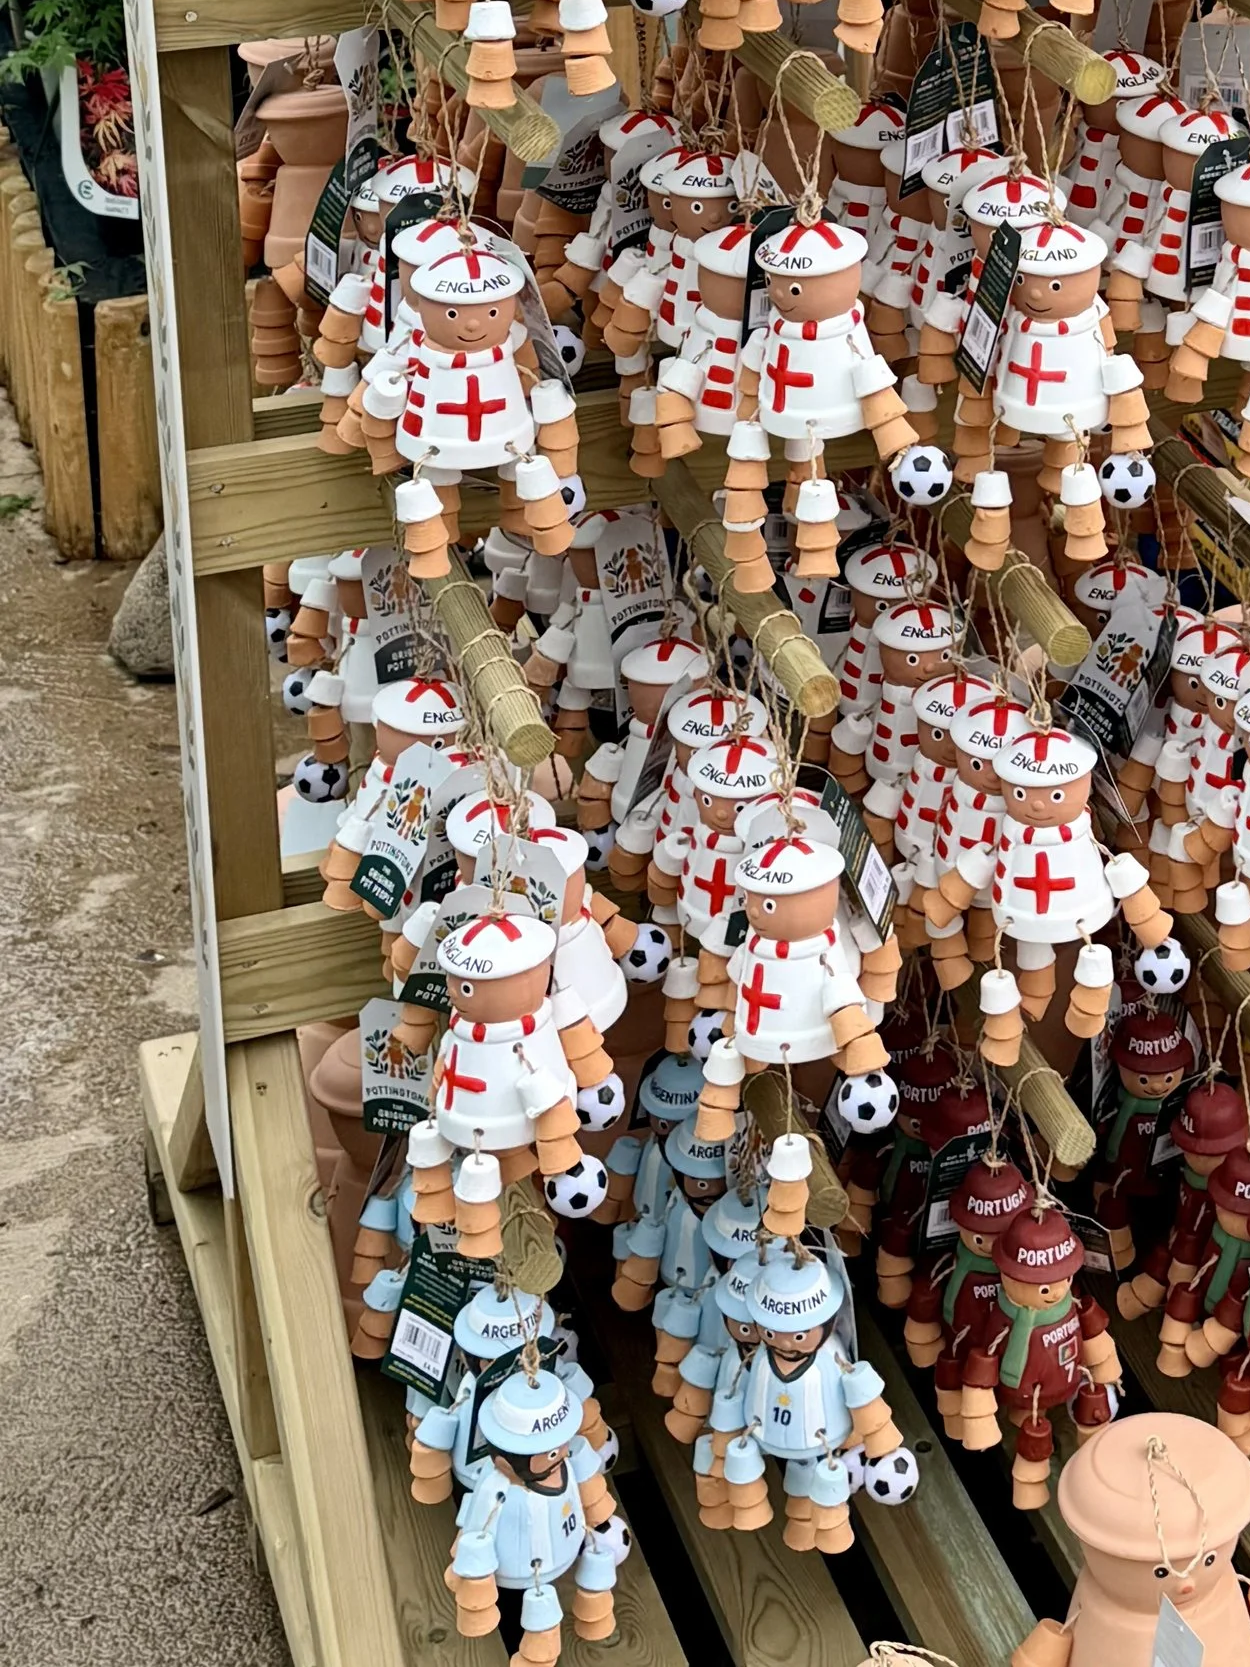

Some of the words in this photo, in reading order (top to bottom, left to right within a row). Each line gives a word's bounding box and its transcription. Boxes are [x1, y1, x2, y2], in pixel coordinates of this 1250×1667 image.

[757, 244, 813, 270] ENGLAND
[435, 275, 511, 295] ENGLAND
[1080, 699, 1113, 730] ORIGINAL
[1010, 752, 1079, 775] ENGLAND
[699, 763, 766, 788] ENGLAND
[370, 840, 413, 876] POTTINGTONS
[360, 875, 372, 889] POT
[372, 884, 394, 907] PEOPLE
[443, 936, 493, 974] ENGLAND
[415, 989, 436, 1002] POT
[366, 1087, 429, 1106] POTTINGTONS
[372, 1117, 389, 1130] POT
[759, 1288, 828, 1316] ARGENTINA
[1063, 1362, 1075, 1384] 7
[771, 1406, 792, 1426] 10
[561, 1513, 577, 1536] 10
